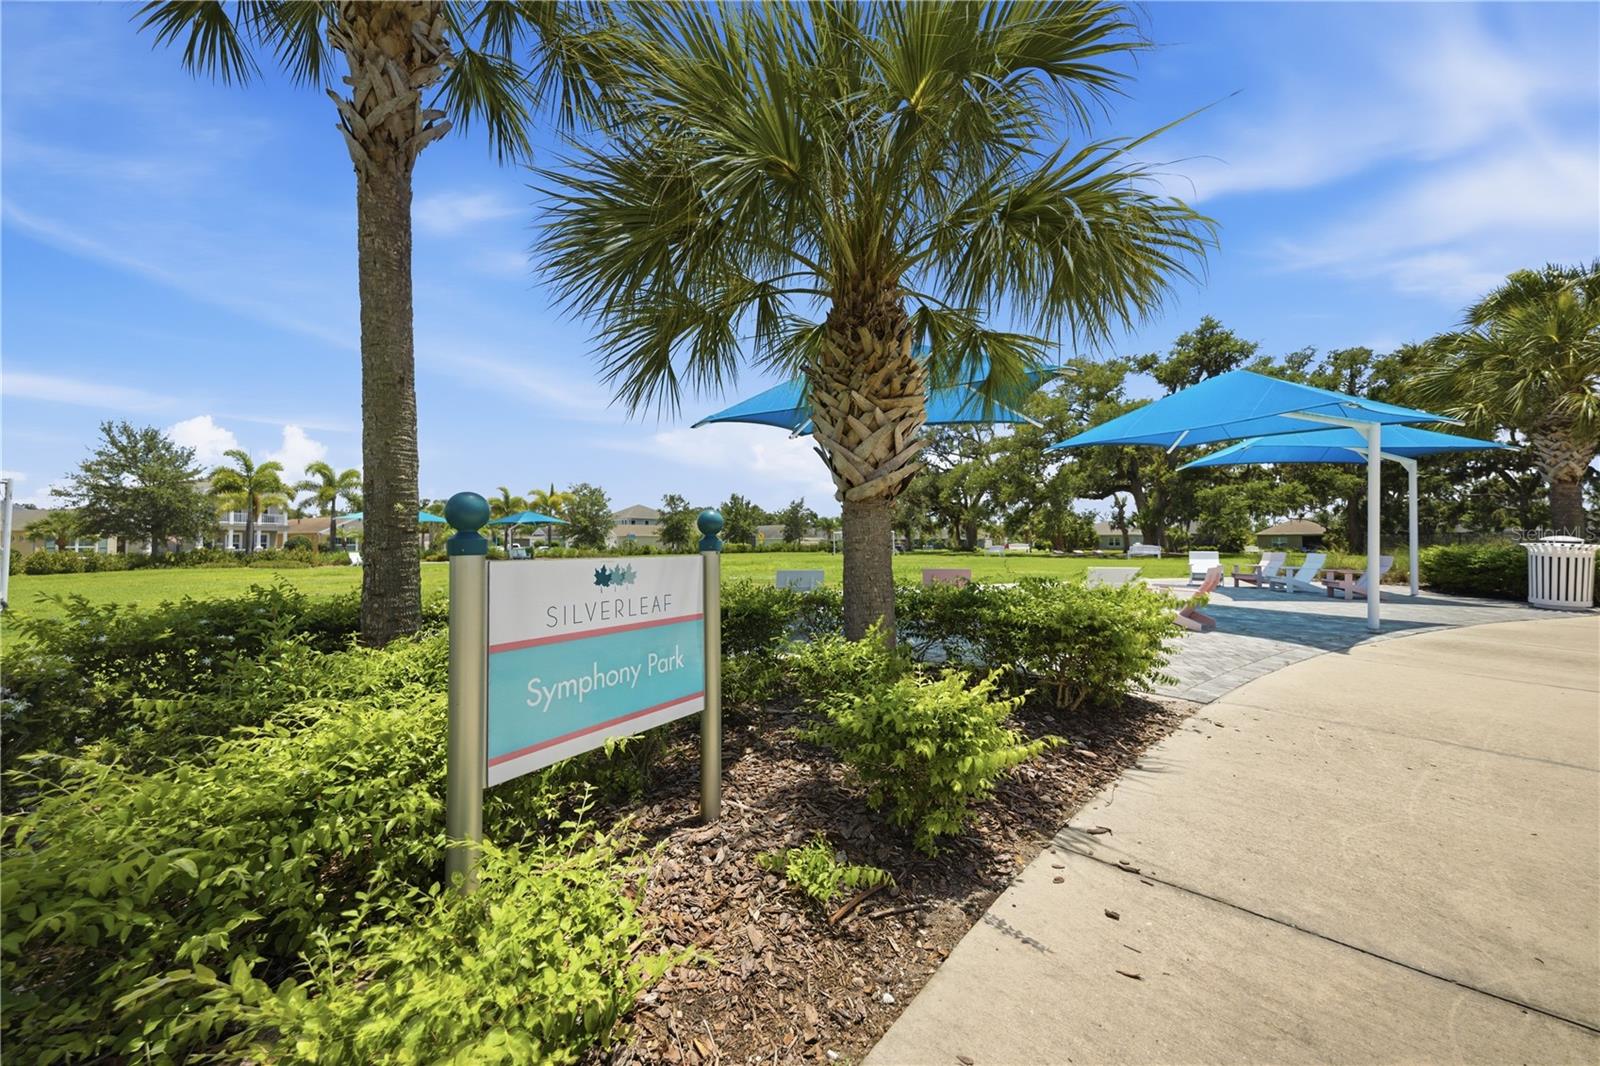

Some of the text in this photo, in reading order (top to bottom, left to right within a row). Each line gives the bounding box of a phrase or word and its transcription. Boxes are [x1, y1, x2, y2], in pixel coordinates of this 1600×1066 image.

[546, 594, 672, 628] SILVERLEAF
[526, 645, 685, 712] Symphony Park
